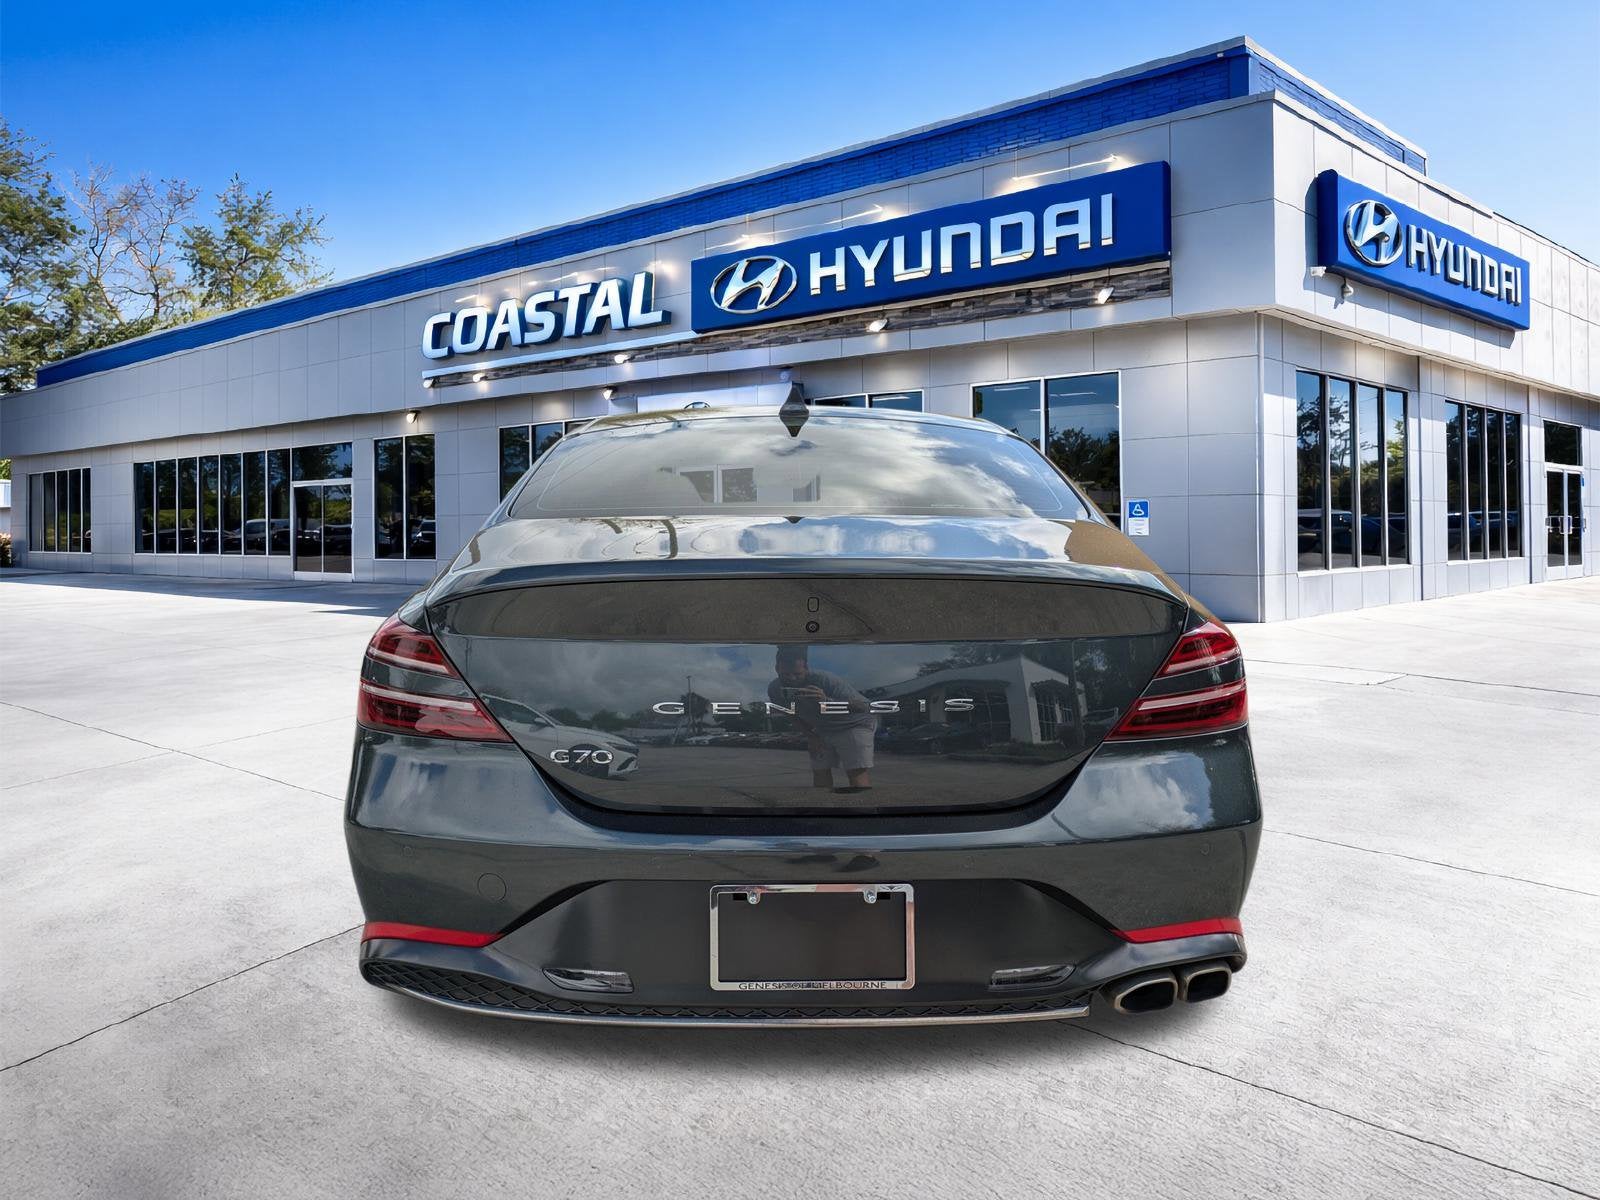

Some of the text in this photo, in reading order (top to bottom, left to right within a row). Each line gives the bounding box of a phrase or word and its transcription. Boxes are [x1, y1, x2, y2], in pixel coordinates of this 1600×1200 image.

[809, 193, 1114, 296] HYUNDAI
[1407, 224, 1522, 305] HYUNDAI
[422, 271, 667, 360] COASTAL
[652, 698, 975, 716] GENESIS
[549, 749, 614, 765] G70
[738, 981, 788, 991] GENESIS
